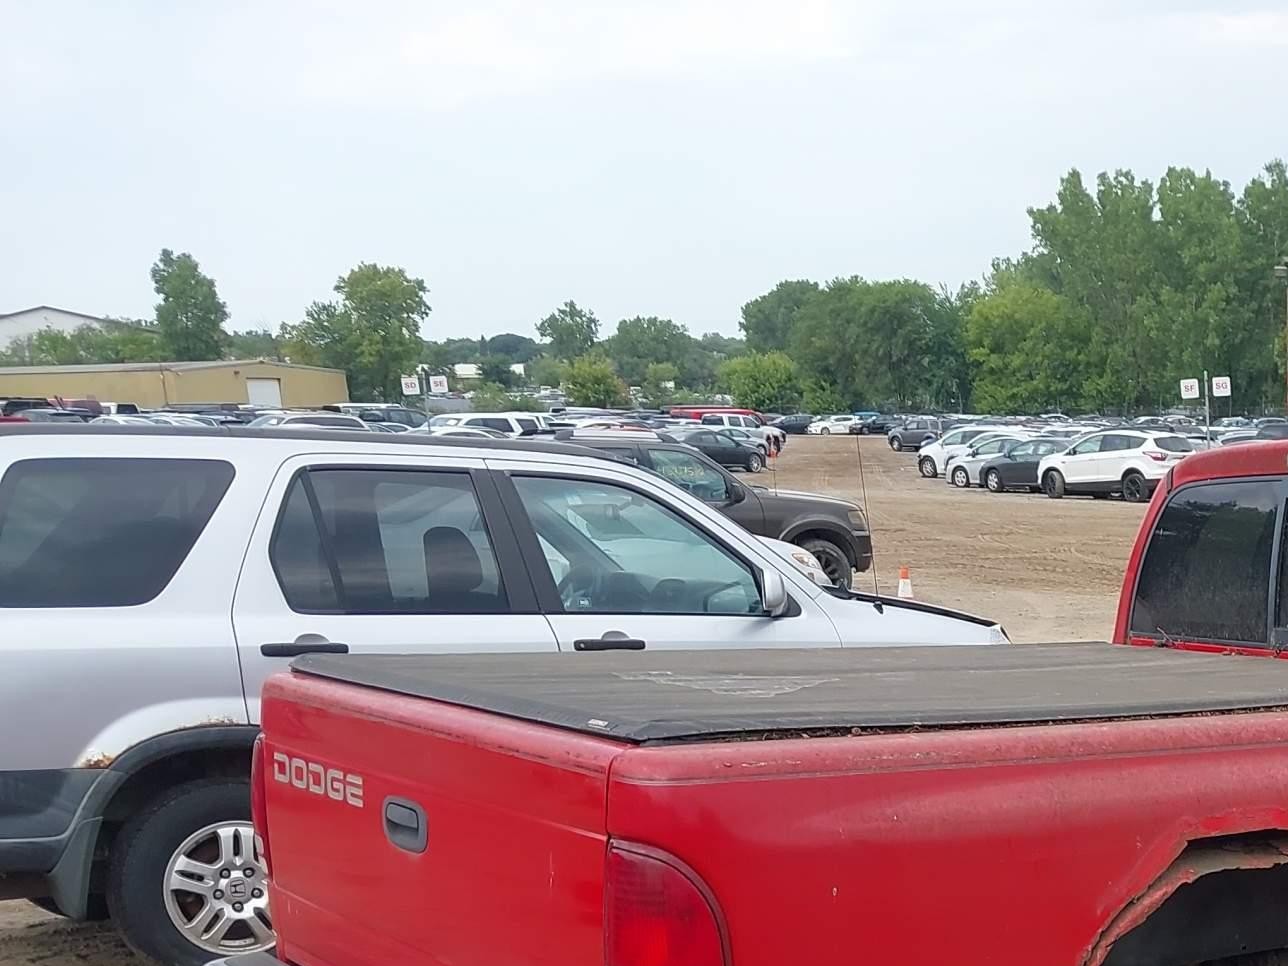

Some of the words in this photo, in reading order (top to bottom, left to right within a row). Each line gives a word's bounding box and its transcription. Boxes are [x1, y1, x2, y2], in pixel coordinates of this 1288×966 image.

[433, 380, 445, 388] SE
[1215, 382, 1228, 390] SG
[273, 751, 364, 808] DODGE
